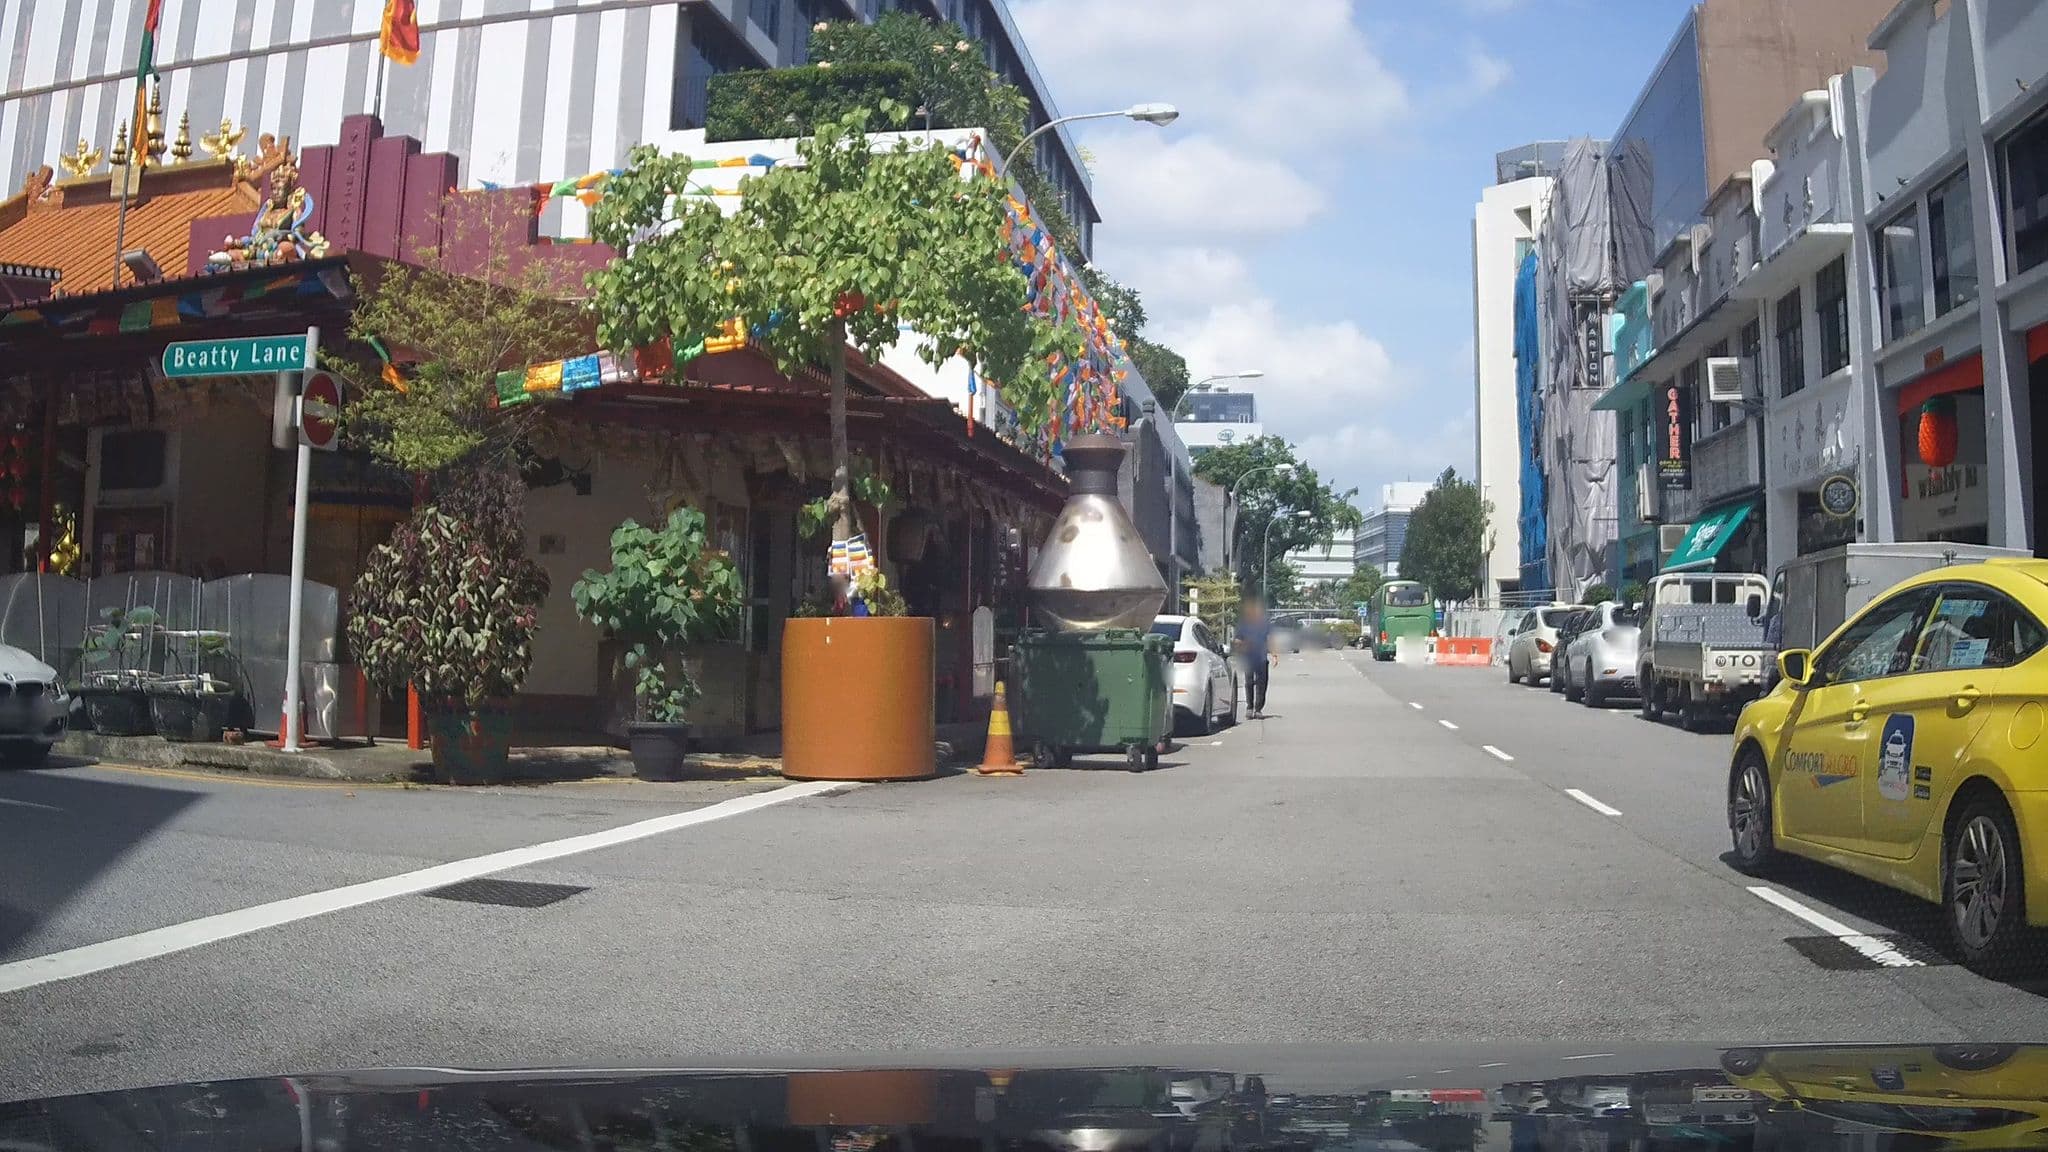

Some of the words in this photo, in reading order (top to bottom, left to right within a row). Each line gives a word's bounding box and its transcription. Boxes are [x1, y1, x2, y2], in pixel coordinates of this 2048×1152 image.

[174, 346, 240, 370] Beatty
[251, 343, 300, 364] Lane
[1667, 387, 1681, 459] GATHER
